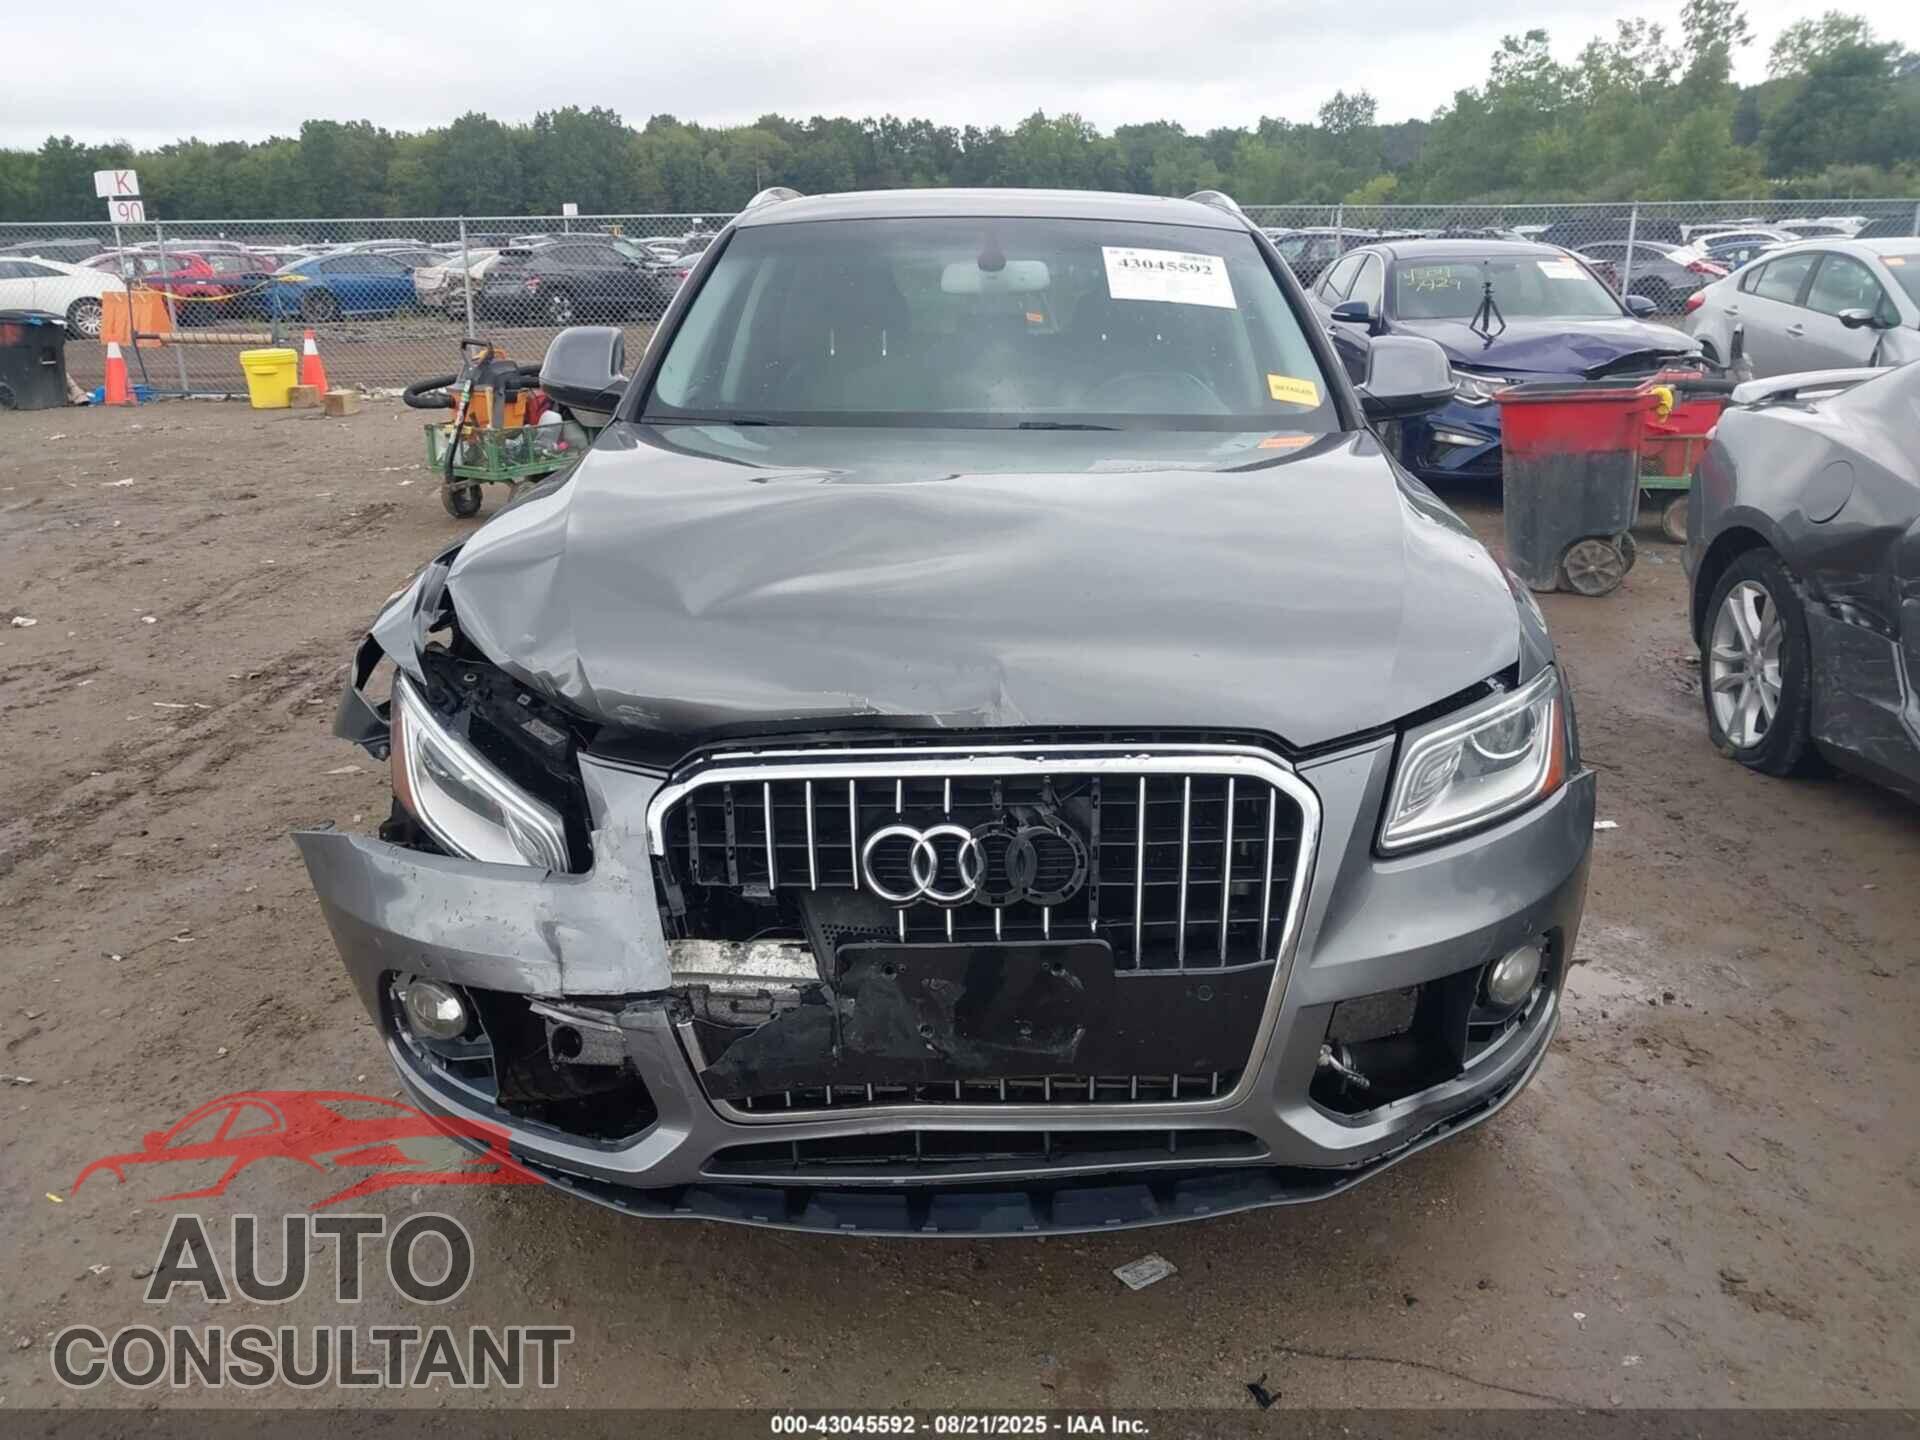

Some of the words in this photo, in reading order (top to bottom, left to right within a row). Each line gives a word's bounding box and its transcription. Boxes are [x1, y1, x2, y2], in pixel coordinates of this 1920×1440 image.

[114, 171, 133, 194] K
[117, 202, 143, 223] 90
[1118, 258, 1213, 275] 43045592
